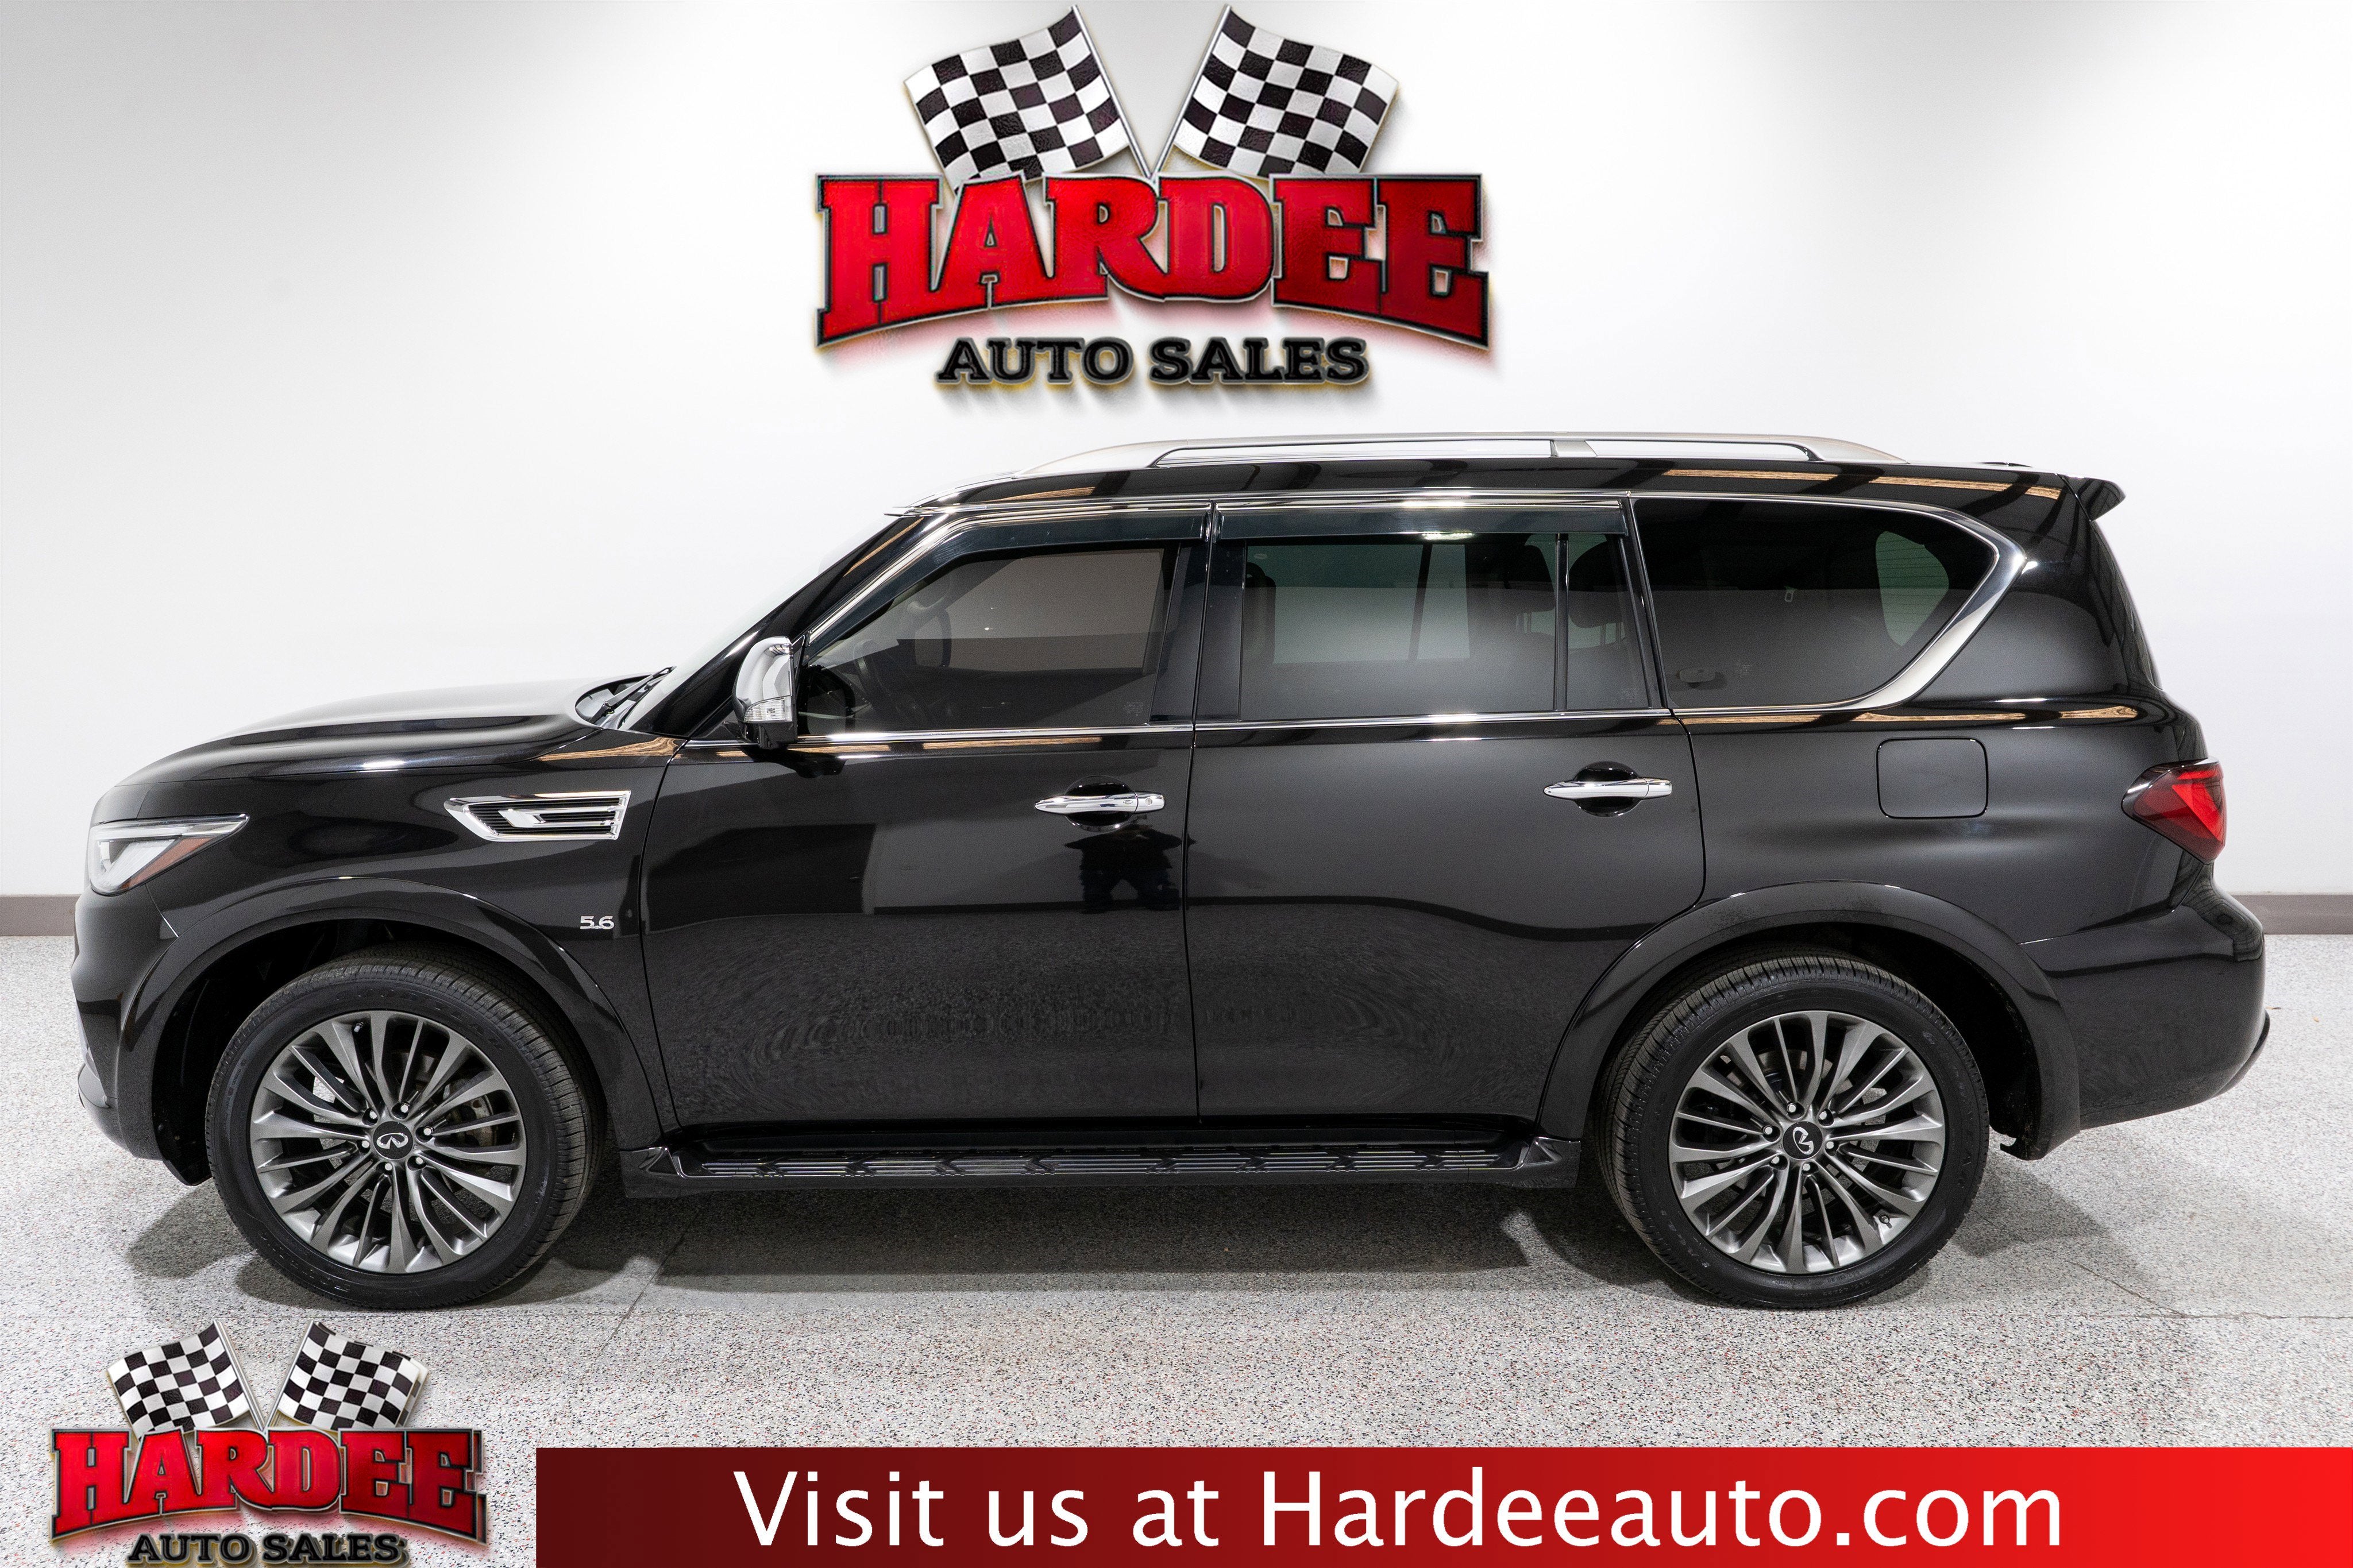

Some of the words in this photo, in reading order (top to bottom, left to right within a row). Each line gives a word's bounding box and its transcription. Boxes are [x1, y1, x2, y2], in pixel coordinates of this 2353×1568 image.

[816, 173, 1490, 349] HARDEE
[935, 337, 1135, 384] AUTO
[1149, 337, 1370, 384] SALES
[580, 916, 615, 929] 5.6
